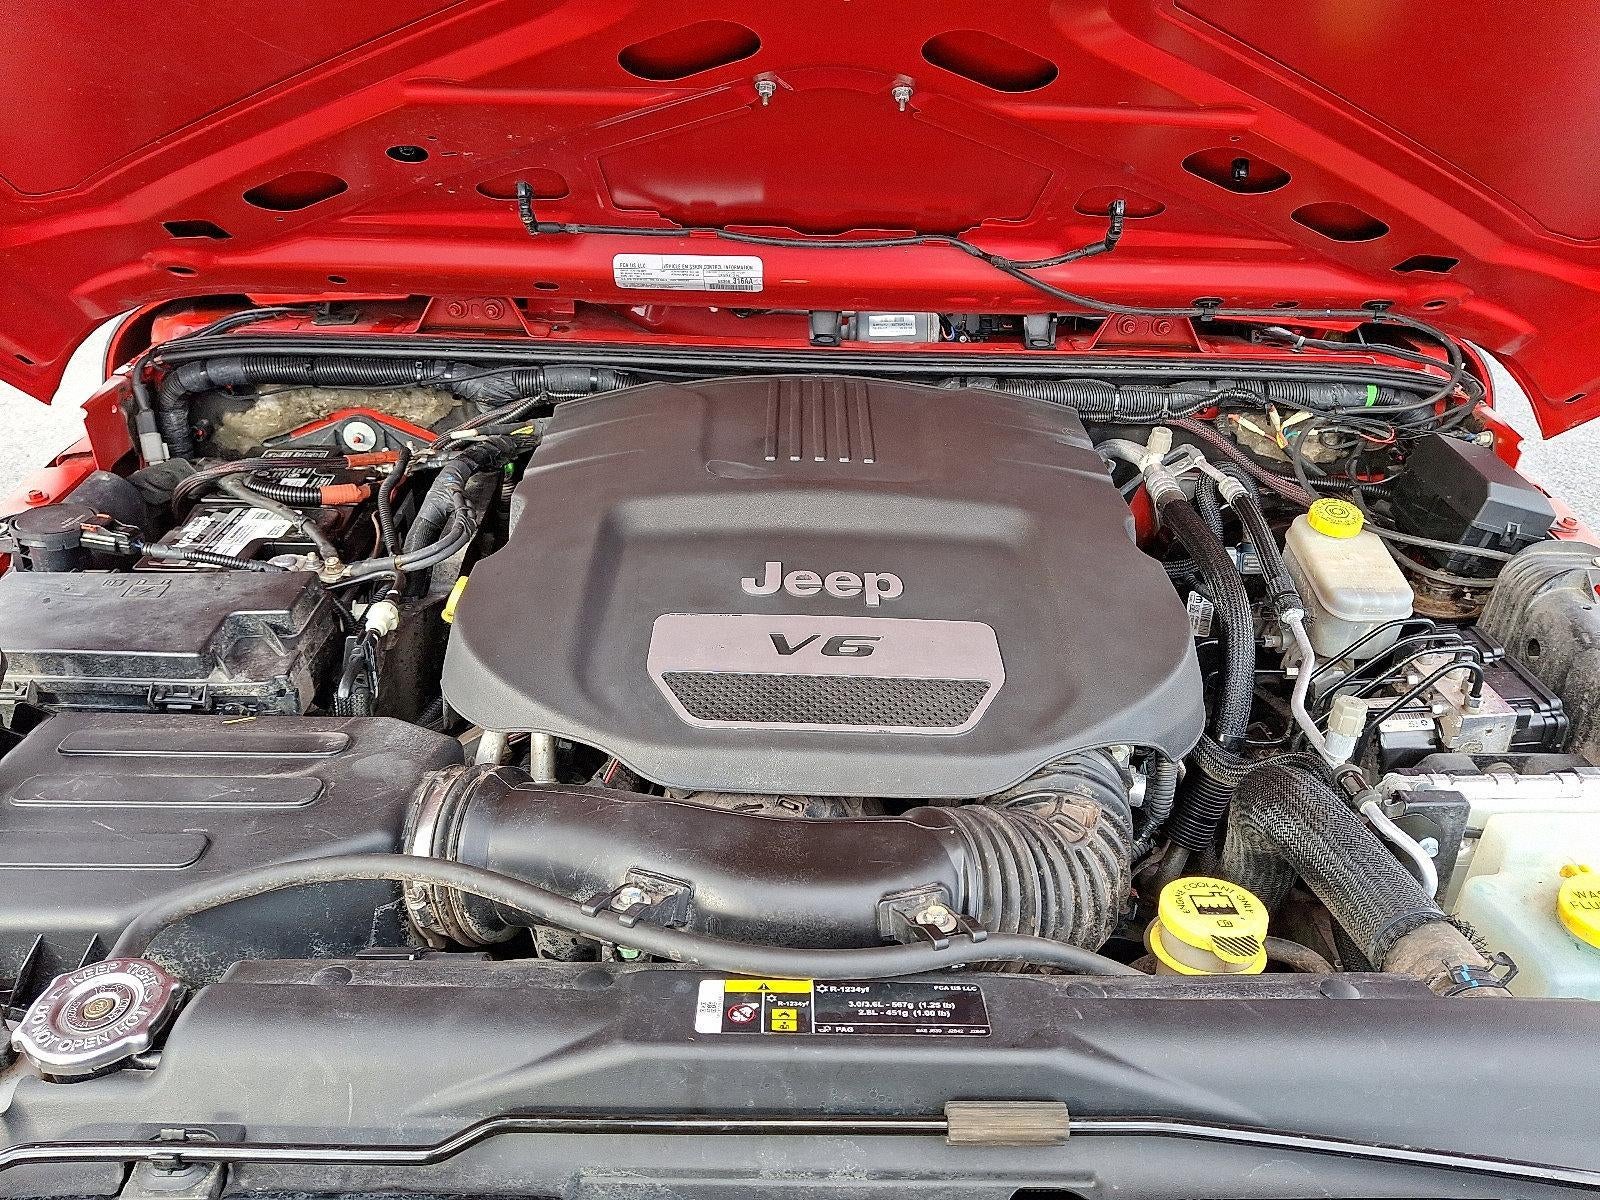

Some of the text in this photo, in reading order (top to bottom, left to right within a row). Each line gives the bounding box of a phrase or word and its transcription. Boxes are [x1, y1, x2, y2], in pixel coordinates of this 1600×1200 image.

[741, 561, 904, 607] Jeep
[769, 633, 882, 657] V6
[1184, 881, 1235, 894] COOLANT
[69, 962, 160, 987] KEEP TIGHT
[829, 986, 870, 994] R-1234yf
[777, 1000, 809, 1008] R-1234yf
[886, 1009, 908, 1017] 451g
[913, 1009, 935, 1017] (1.00
[936, 1009, 950, 1017] lb)
[891, 1001, 914, 1009] 567g
[32, 1004, 51, 1025] DO
[114, 1005, 148, 1035] HOT
[32, 1024, 60, 1048] NOT
[58, 1035, 111, 1051] OPEN
